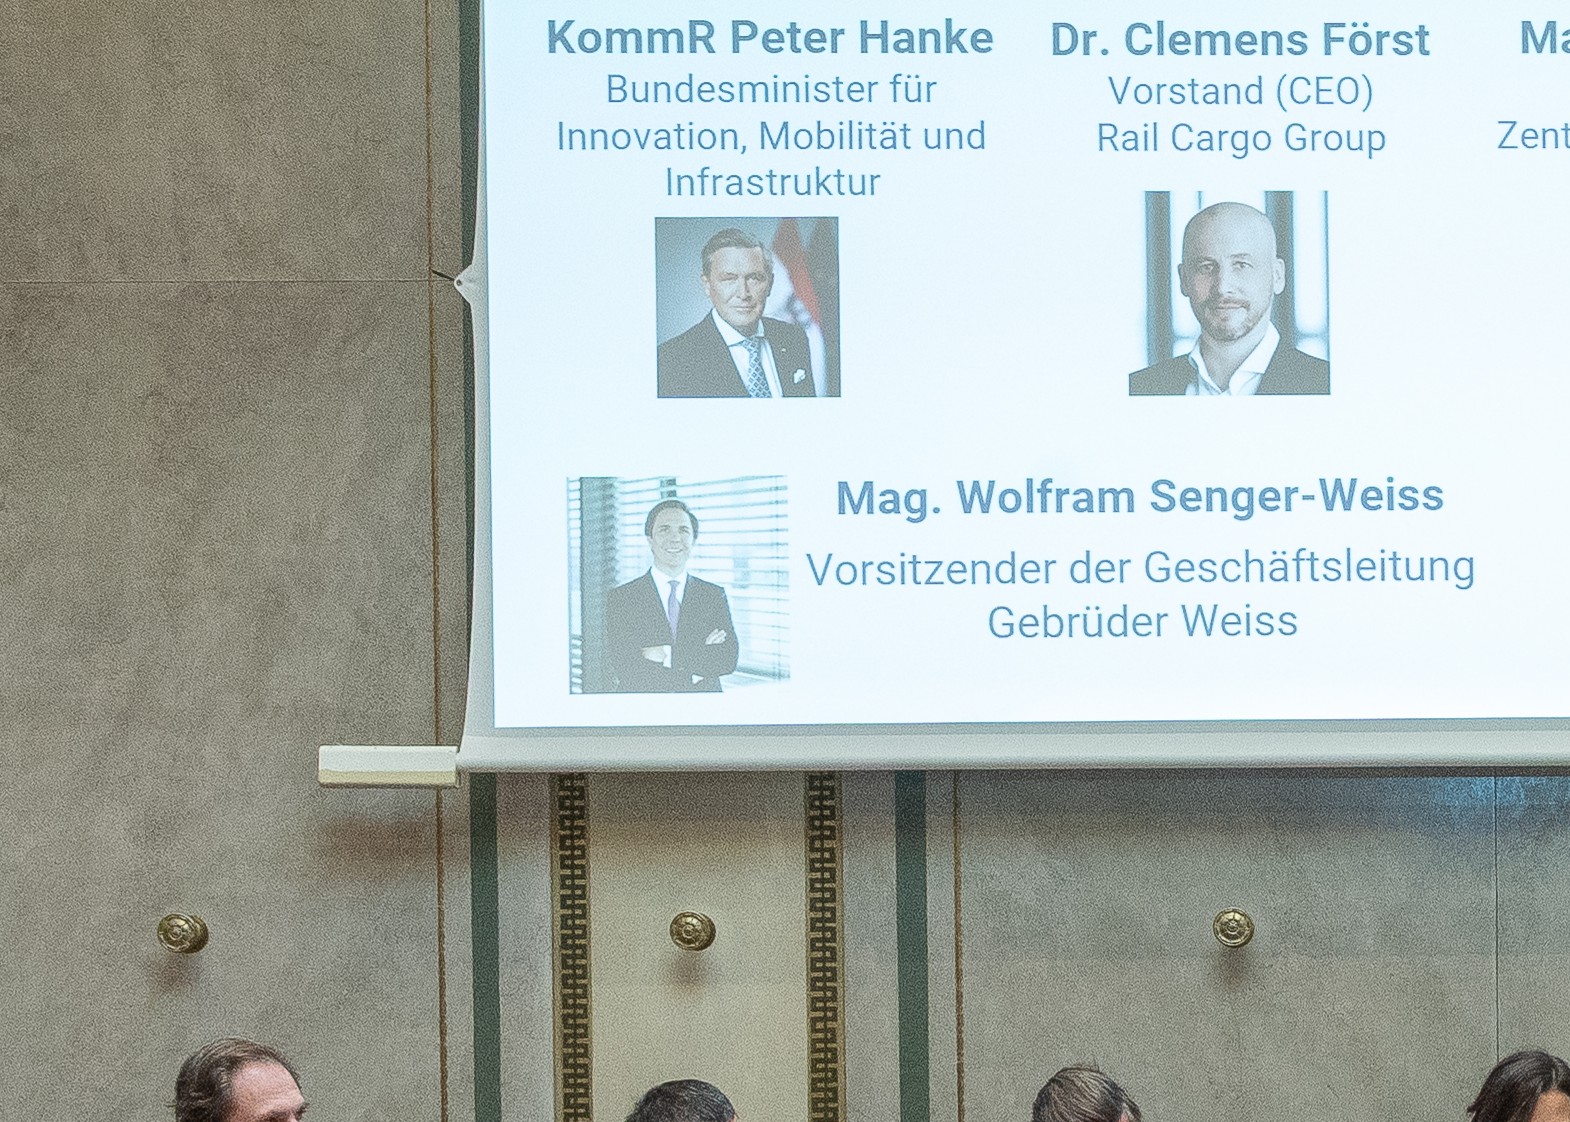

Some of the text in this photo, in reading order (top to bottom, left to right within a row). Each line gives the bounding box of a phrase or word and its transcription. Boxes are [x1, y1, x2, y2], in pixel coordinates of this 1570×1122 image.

[547, 18, 994, 54] KommR Peter Hanke
[1051, 19, 1431, 56] Dr. Clemens Först
[607, 73, 937, 104] Bundesminister für
[1108, 74, 1373, 112] Vorstand (CEO)
[558, 120, 985, 156] Innovation, Mobilität und
[1098, 122, 1386, 160] Rail Cargo Group
[666, 166, 881, 197] Infrastruktur
[837, 476, 1444, 524] Mag. Wolfram Senger-Weiss
[805, 547, 1475, 591] Vorsitzender der Geschäftsleitung
[988, 603, 1298, 639] Gebrüder Weiss
